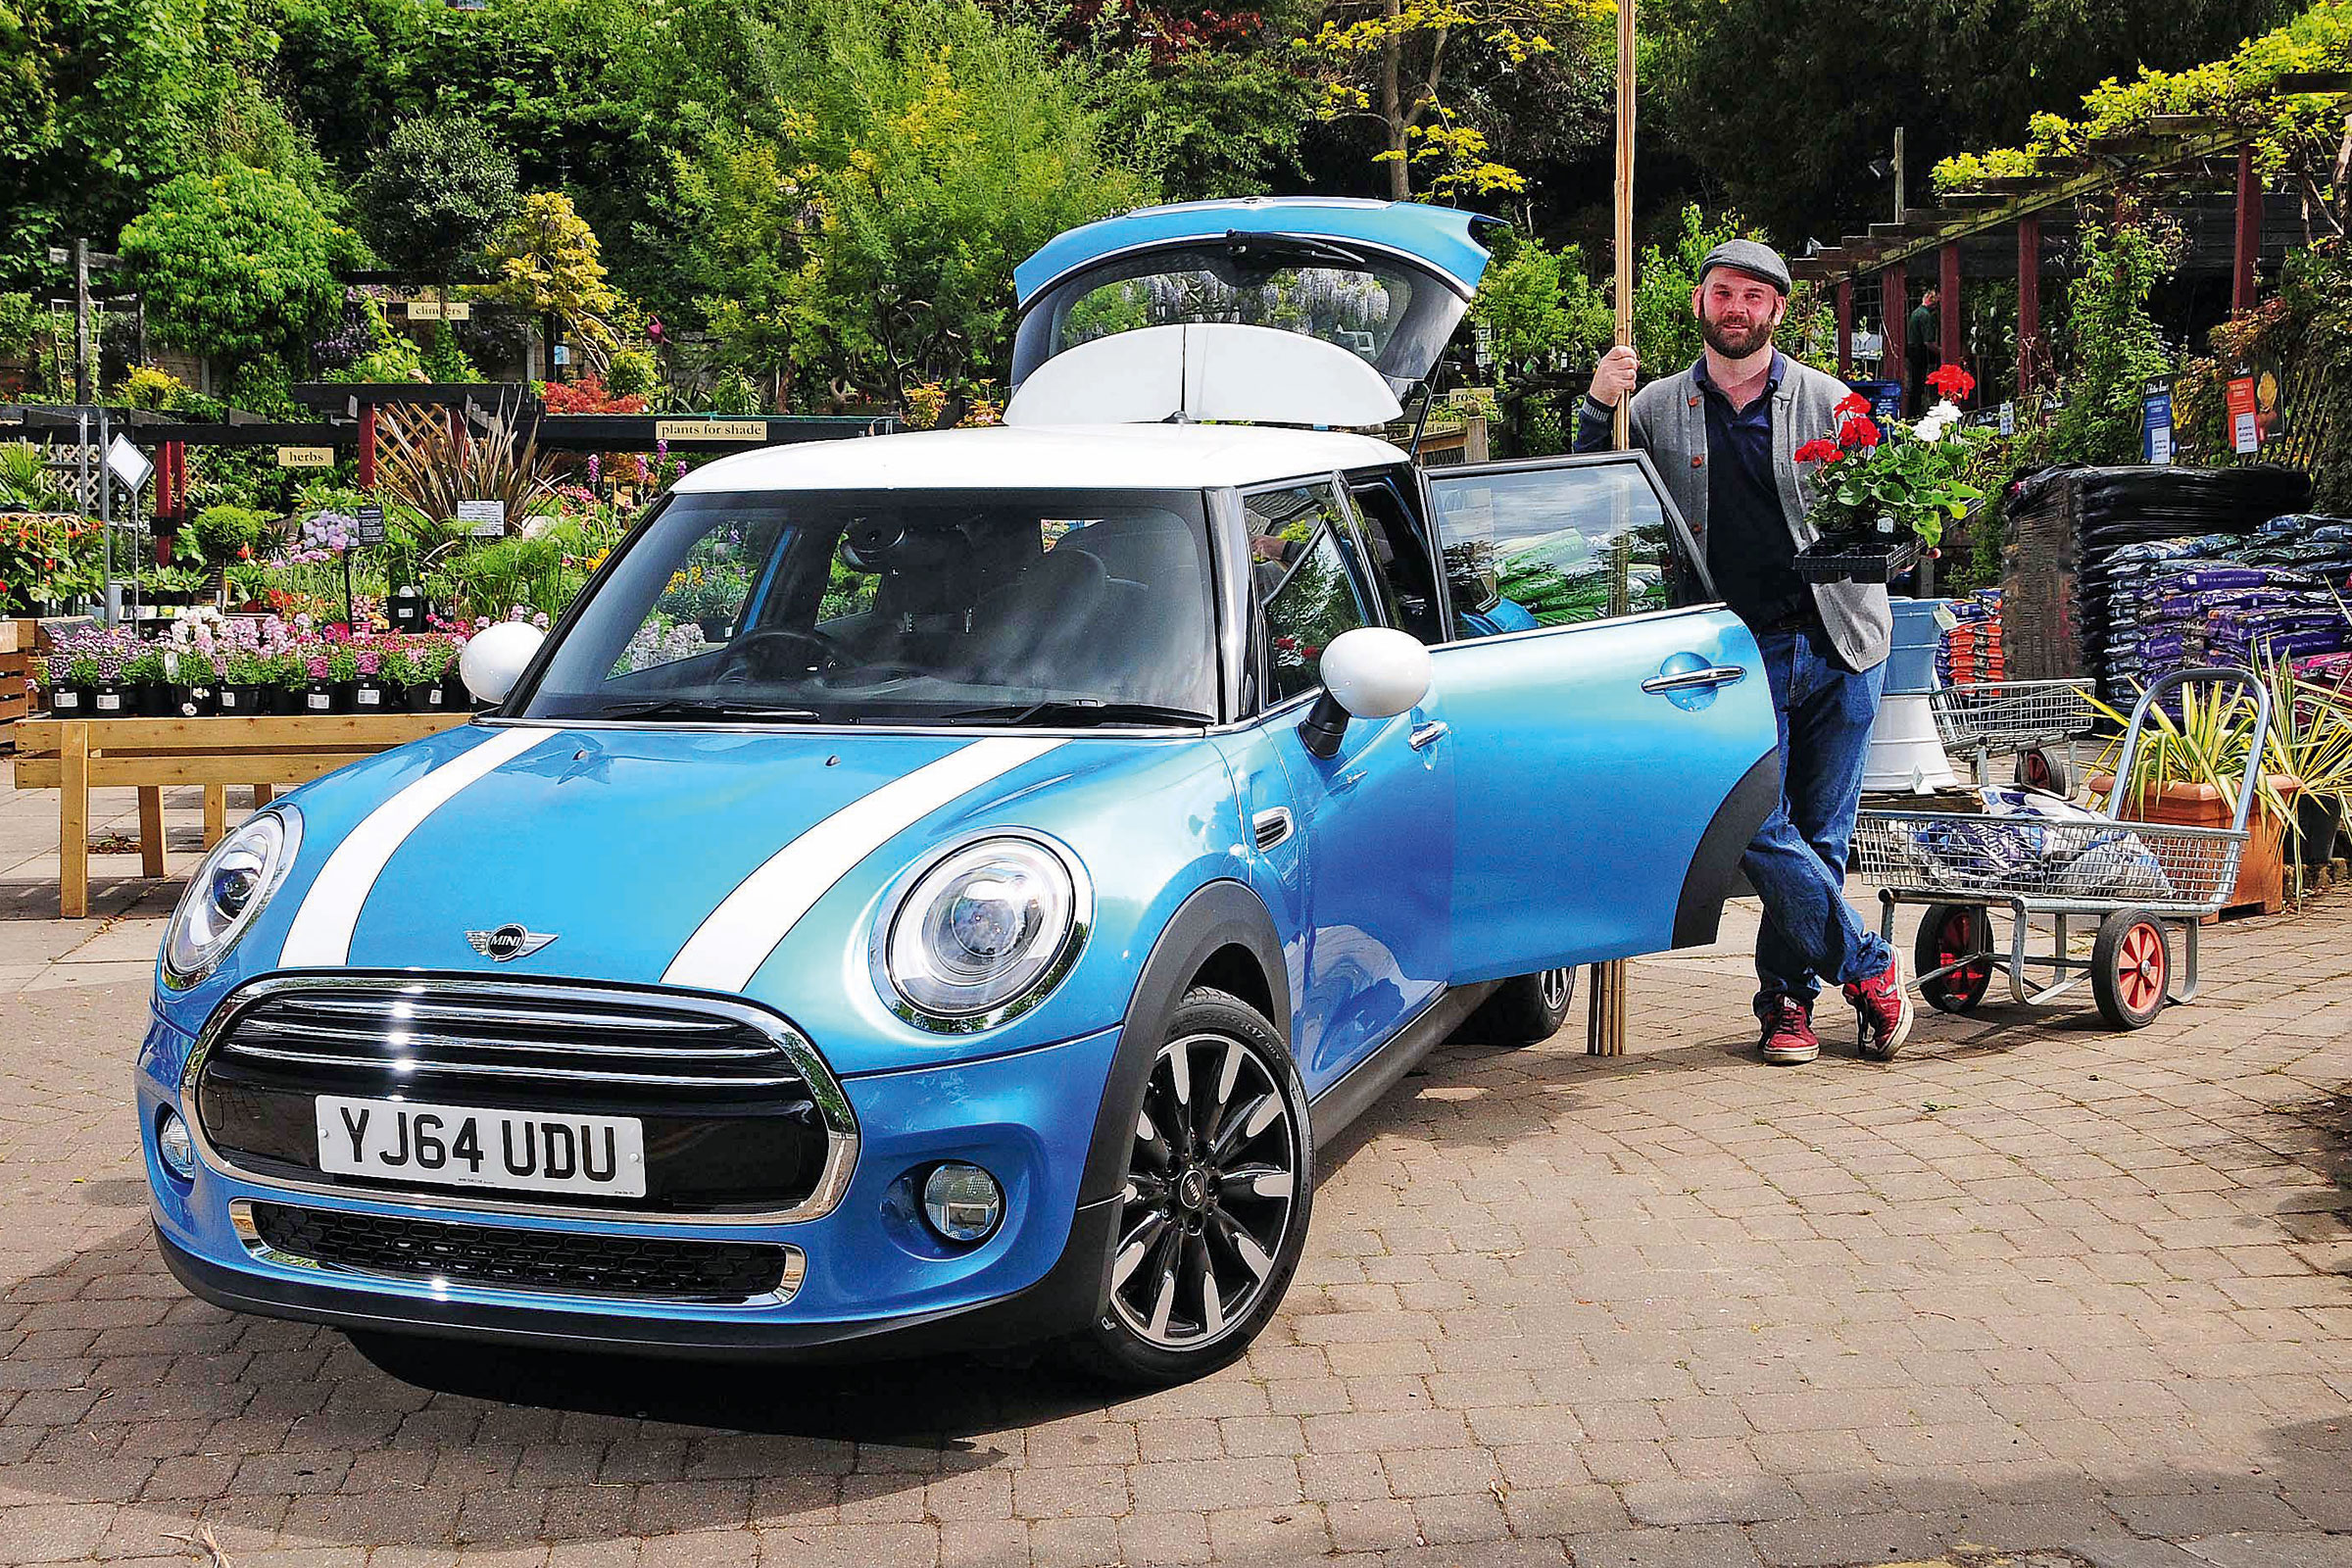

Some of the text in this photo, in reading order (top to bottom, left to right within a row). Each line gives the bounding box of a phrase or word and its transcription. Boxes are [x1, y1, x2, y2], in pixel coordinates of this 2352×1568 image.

[416, 305, 463, 316] climers
[1455, 393, 1490, 403] ros
[662, 423, 761, 437] plants for shade
[288, 451, 324, 462] herbs
[490, 935, 521, 947] MINI
[340, 1106, 616, 1183] YJ64 UDU
